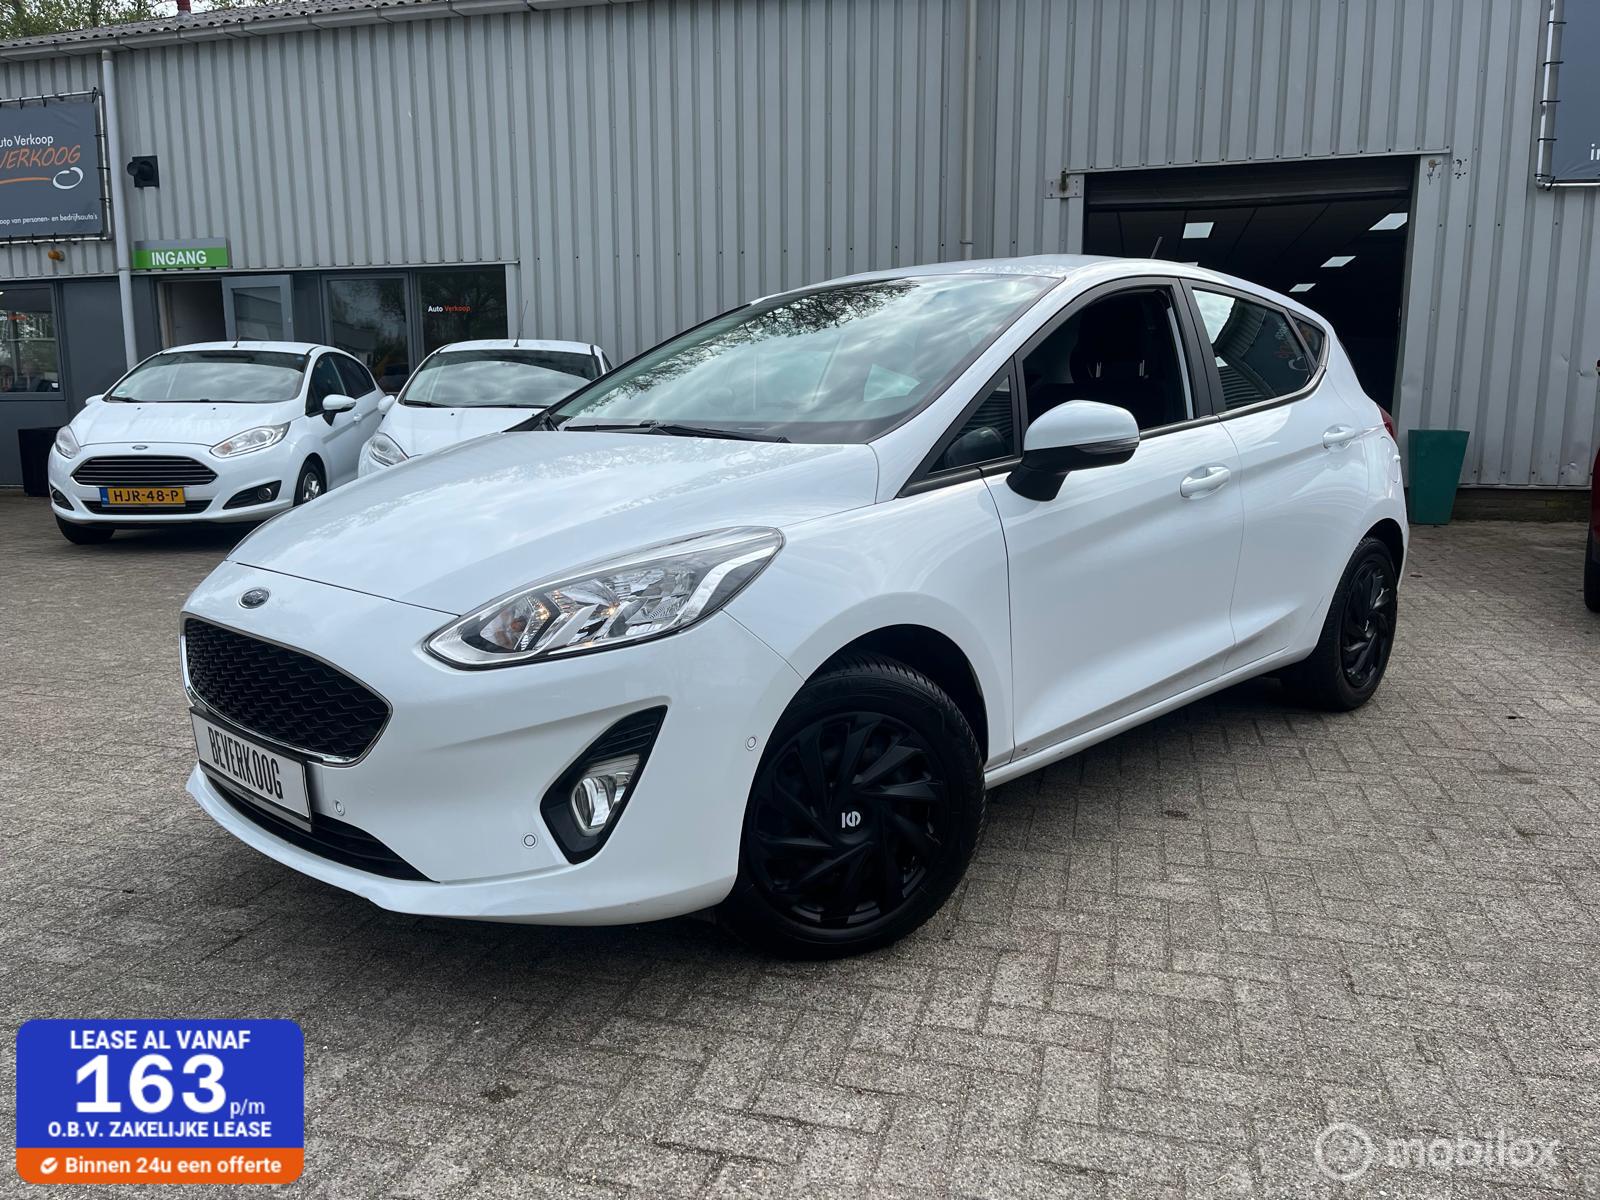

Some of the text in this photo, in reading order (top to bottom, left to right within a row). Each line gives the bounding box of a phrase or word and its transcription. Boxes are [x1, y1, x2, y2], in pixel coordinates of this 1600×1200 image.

[14, 133, 54, 146] Verkoop
[151, 250, 207, 266] INGANG
[113, 490, 179, 502] HJR-48-P
[207, 726, 284, 799] BEVERKOOG
